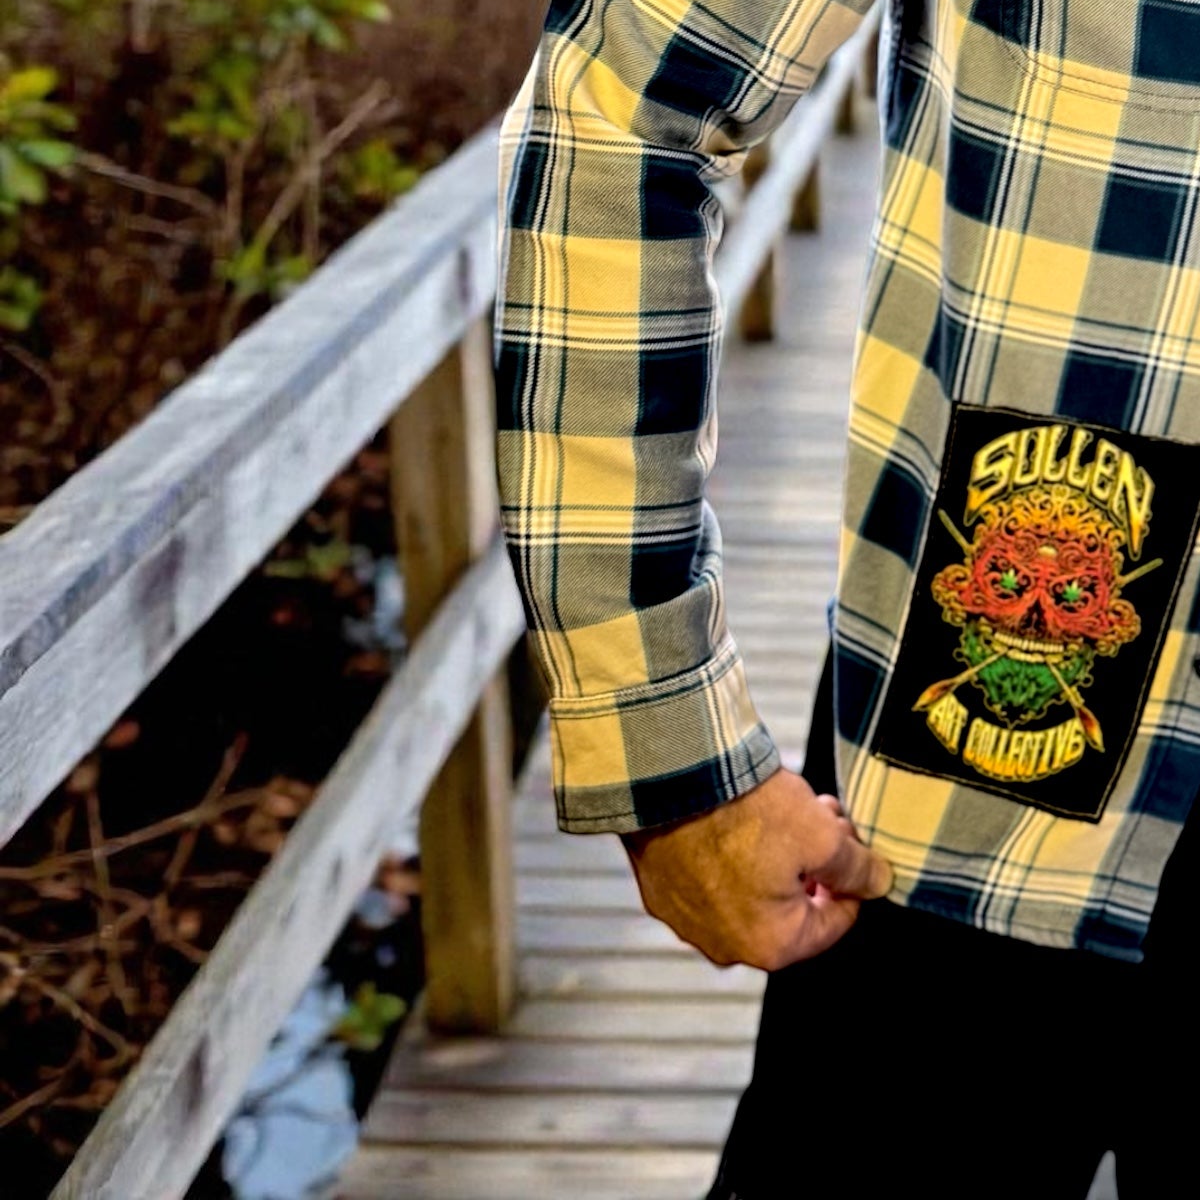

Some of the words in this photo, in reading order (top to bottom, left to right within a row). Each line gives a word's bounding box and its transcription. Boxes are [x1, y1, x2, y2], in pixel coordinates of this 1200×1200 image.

[963, 424, 1156, 562] SULLEN
[926, 691, 969, 754] ART
[962, 717, 1086, 783] COLLECTIVE
